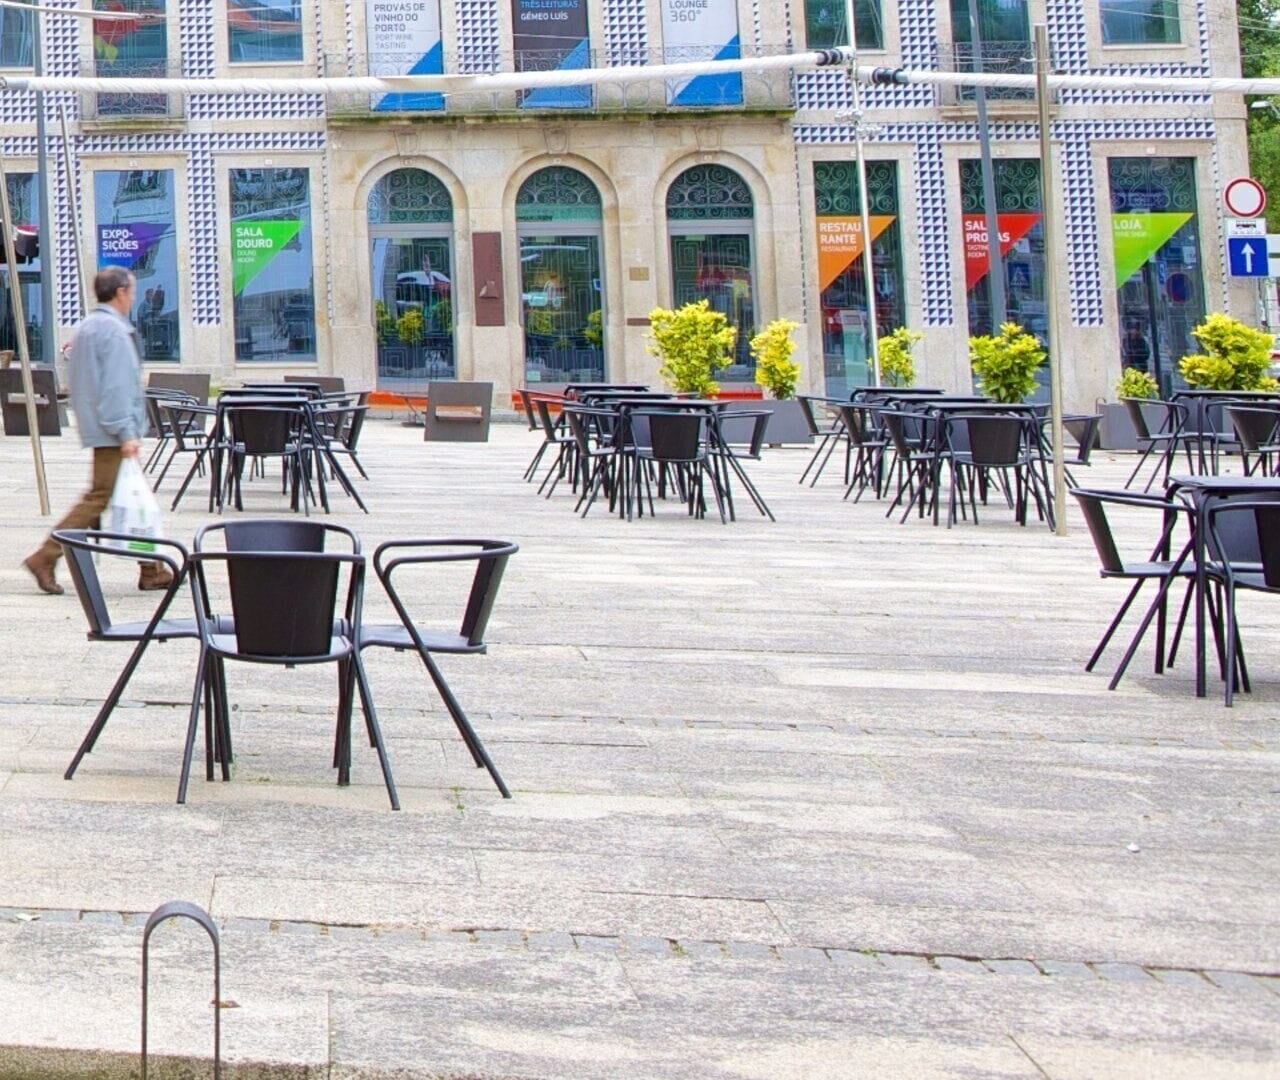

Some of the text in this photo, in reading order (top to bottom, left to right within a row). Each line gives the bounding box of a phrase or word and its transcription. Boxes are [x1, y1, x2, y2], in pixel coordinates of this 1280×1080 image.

[374, 2, 426, 12] PROVAS DE
[669, 0, 708, 9] LOUNGE
[375, 13, 418, 22] VINHO DO
[521, 10, 569, 21] GÉMEO LUÍS
[670, 9, 702, 23] 360°
[375, 23, 407, 32] PORTO
[820, 222, 861, 232] RESTAU
[1114, 219, 1142, 230] LOJA
[102, 229, 133, 239] EXPO-
[236, 227, 263, 236] SALA
[237, 238, 273, 248] DOURO
[821, 233, 857, 244] RANTE
[102, 239, 139, 251] SIÇÕES
